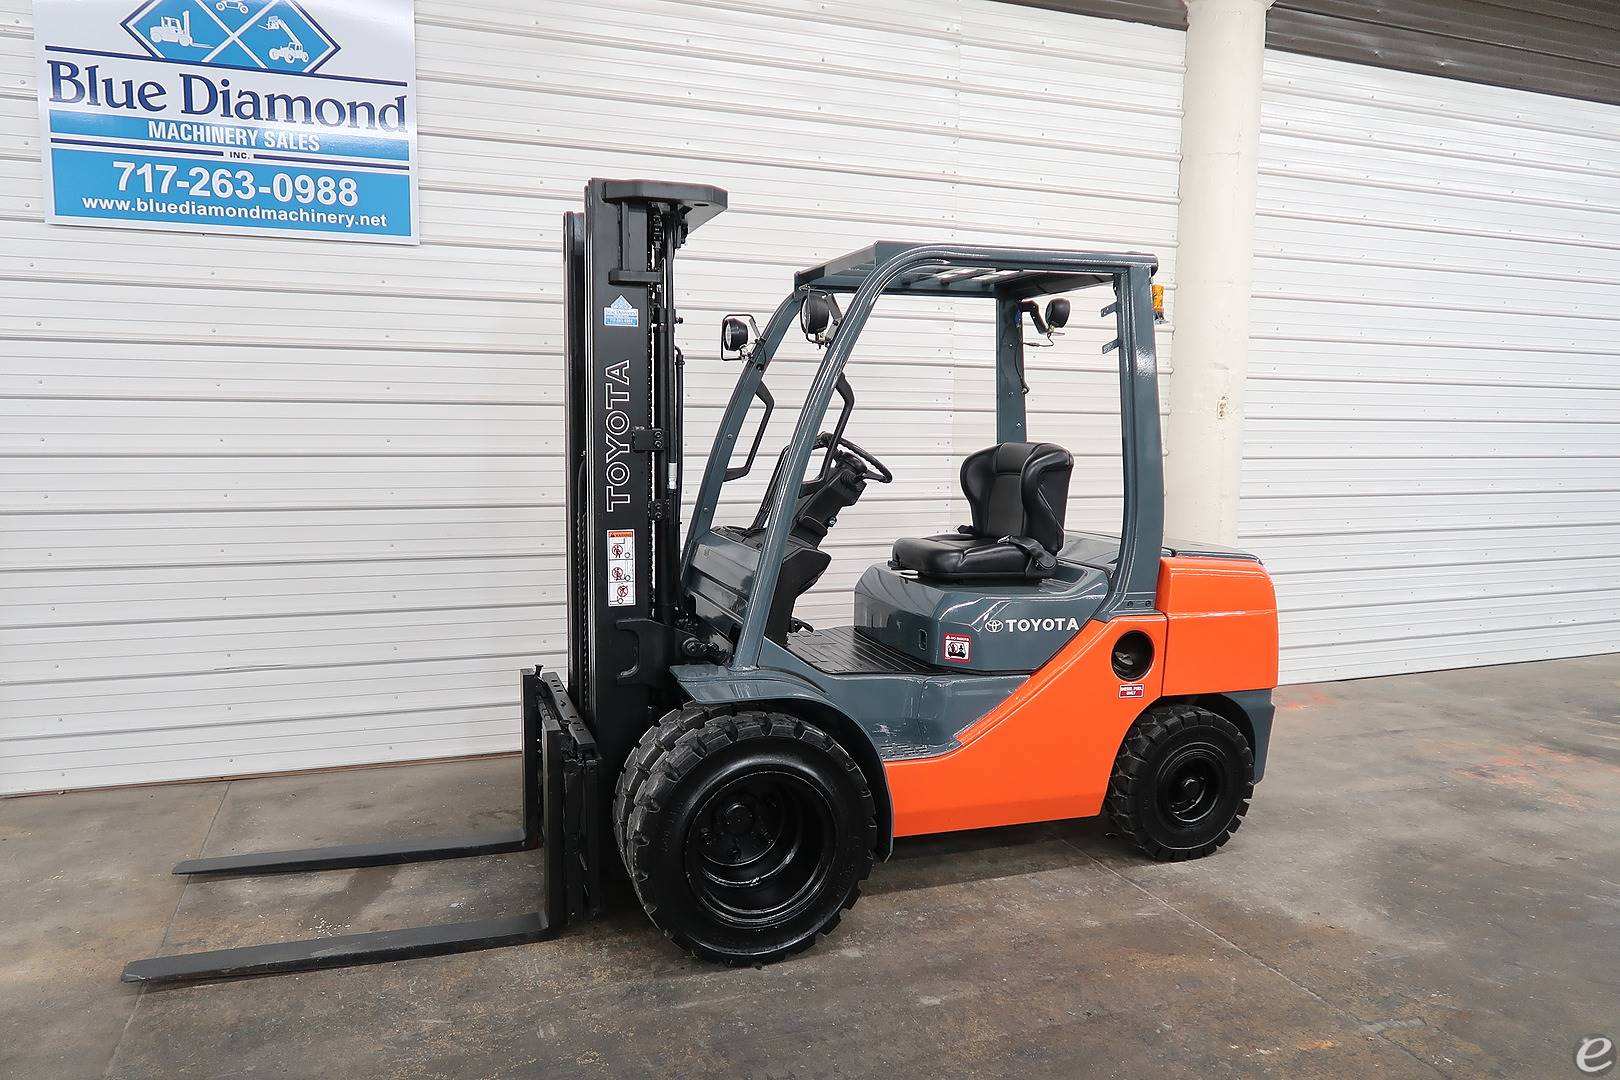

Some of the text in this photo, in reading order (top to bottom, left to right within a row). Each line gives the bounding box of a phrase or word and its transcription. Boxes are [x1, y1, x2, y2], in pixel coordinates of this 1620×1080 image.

[47, 60, 408, 134] Blue Diamond
[148, 120, 320, 151] MACHINERY SALES
[229, 151, 250, 160] INC.
[112, 161, 359, 207] 717-263-0988
[82, 197, 387, 228] www.bluediamondmachinery.net
[605, 359, 631, 513] TOYOTA
[1005, 618, 1080, 633] TOYOTA
